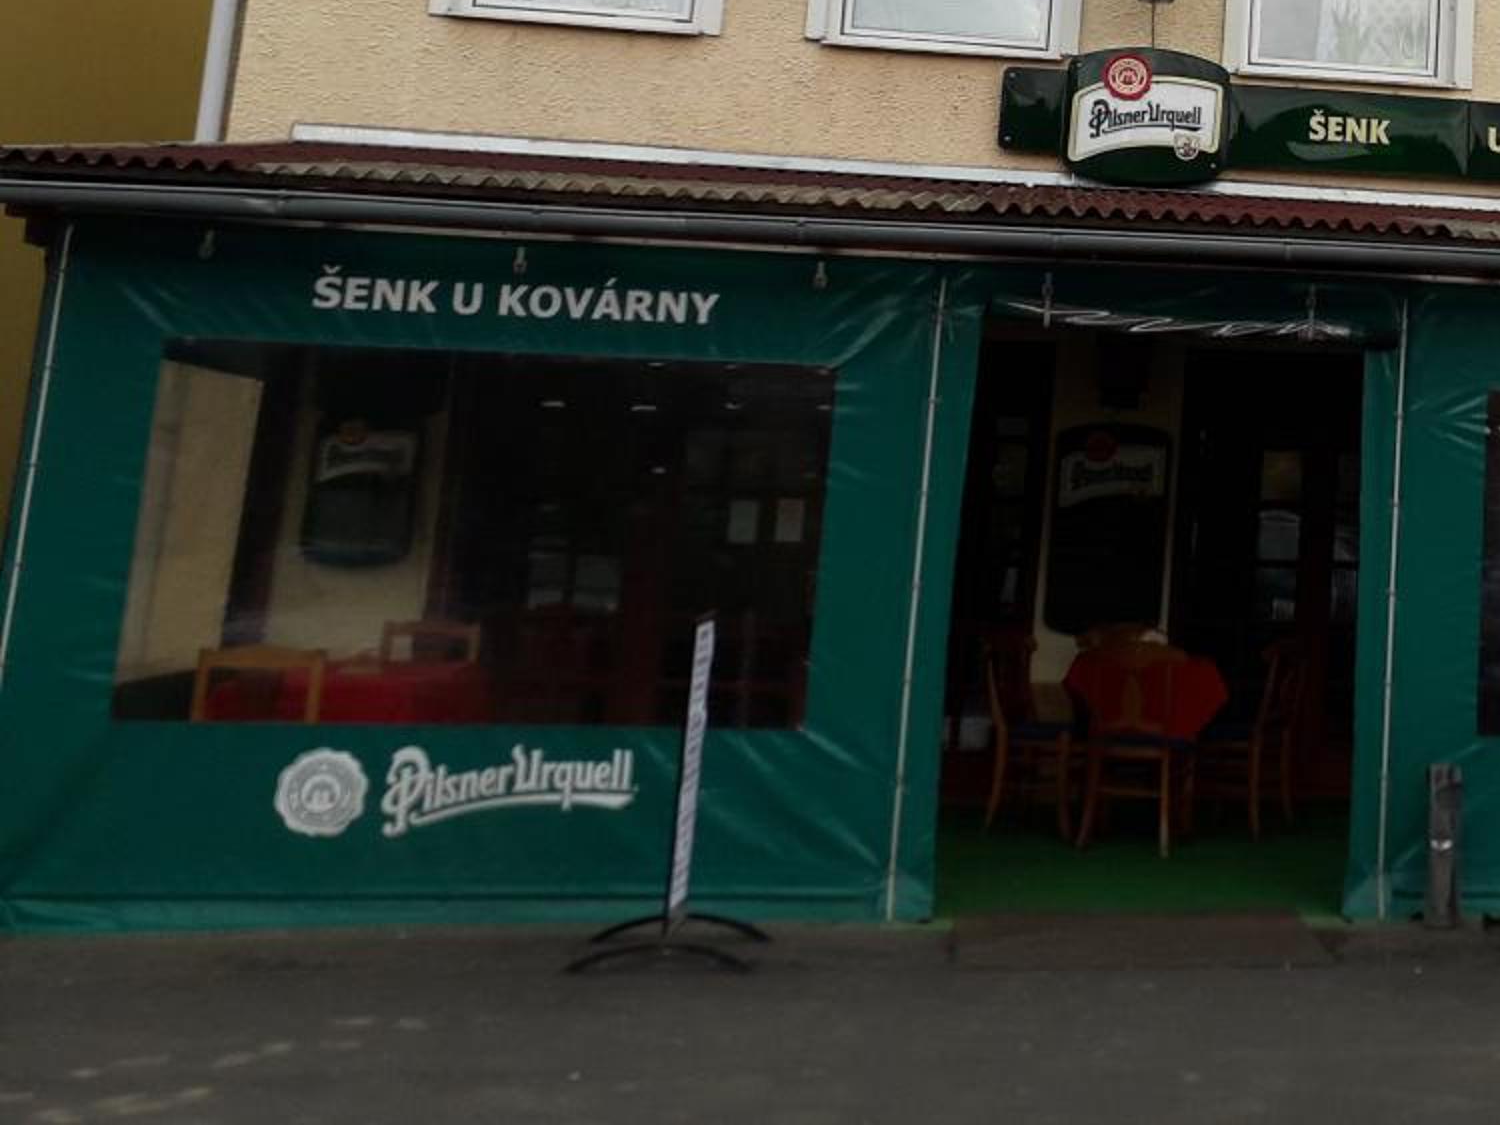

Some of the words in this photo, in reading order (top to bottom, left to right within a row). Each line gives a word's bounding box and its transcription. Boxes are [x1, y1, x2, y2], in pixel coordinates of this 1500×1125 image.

[1089, 98, 1147, 138] Pilsner
[1148, 100, 1202, 131] Urquell
[1308, 108, 1391, 145] ŠENK
[312, 265, 439, 313] ŠENK
[452, 282, 484, 315] U
[498, 277, 721, 325] KOVÁRNY
[381, 745, 514, 837] Pilsner
[511, 743, 635, 812] Urquell
